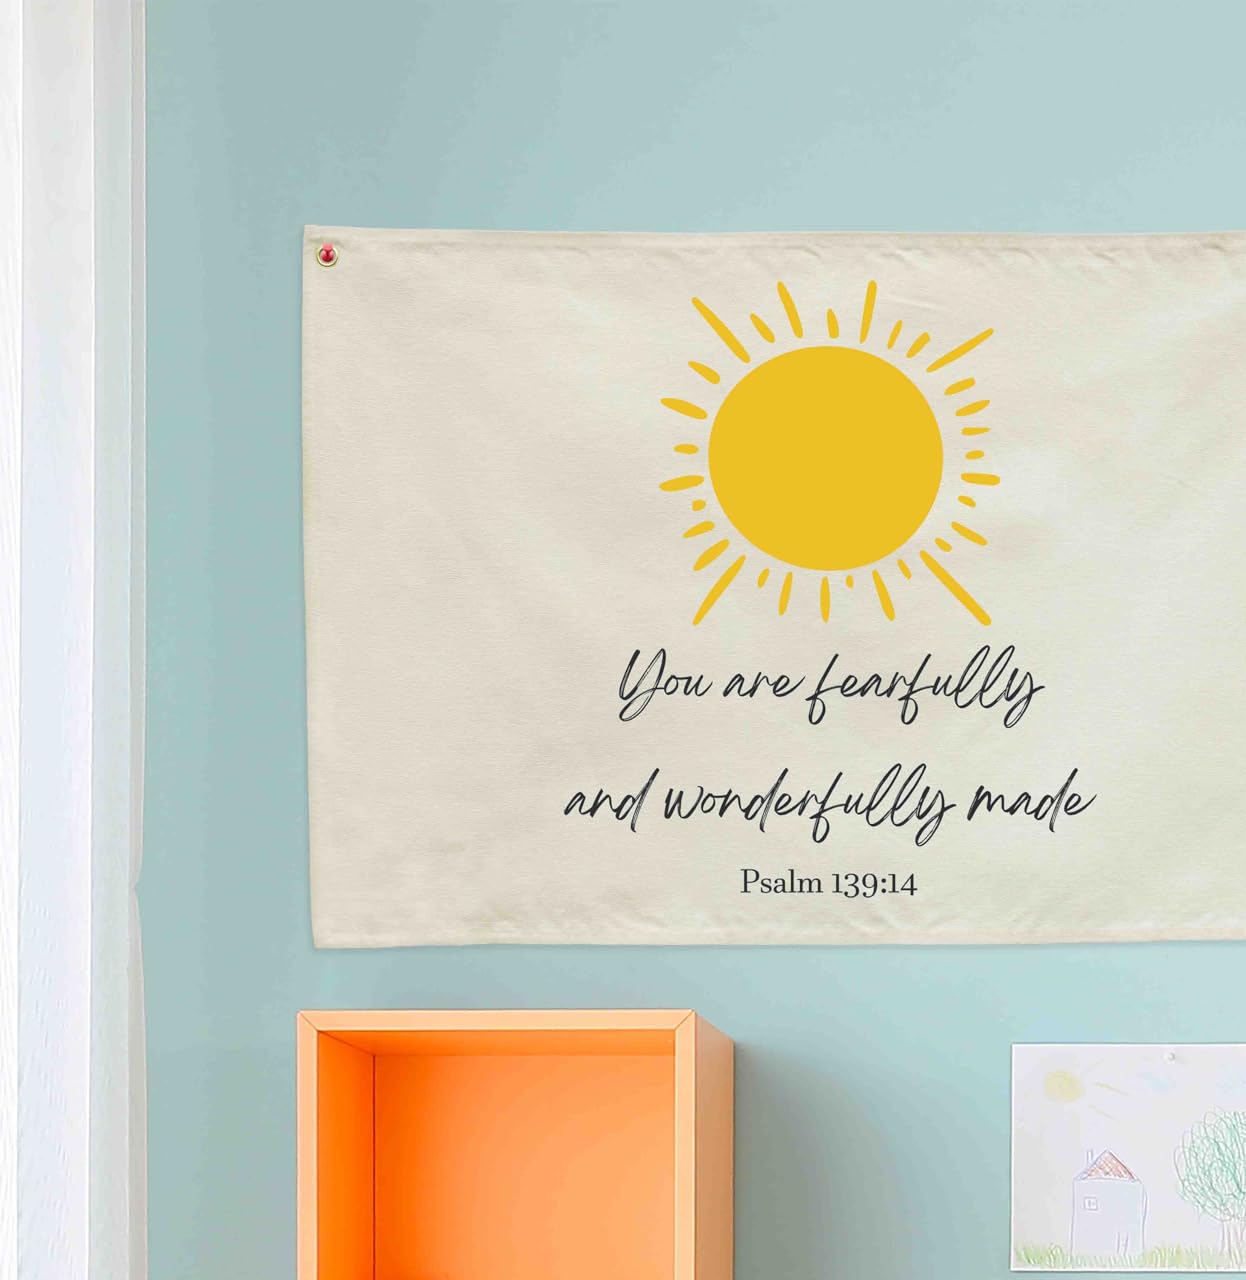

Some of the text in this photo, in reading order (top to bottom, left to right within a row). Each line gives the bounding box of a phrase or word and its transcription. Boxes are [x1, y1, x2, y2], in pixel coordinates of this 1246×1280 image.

[619, 645, 1045, 728] You are fearfully
[564, 763, 1096, 846] and wonderfully made
[741, 869, 917, 898] Psalm 139:14
